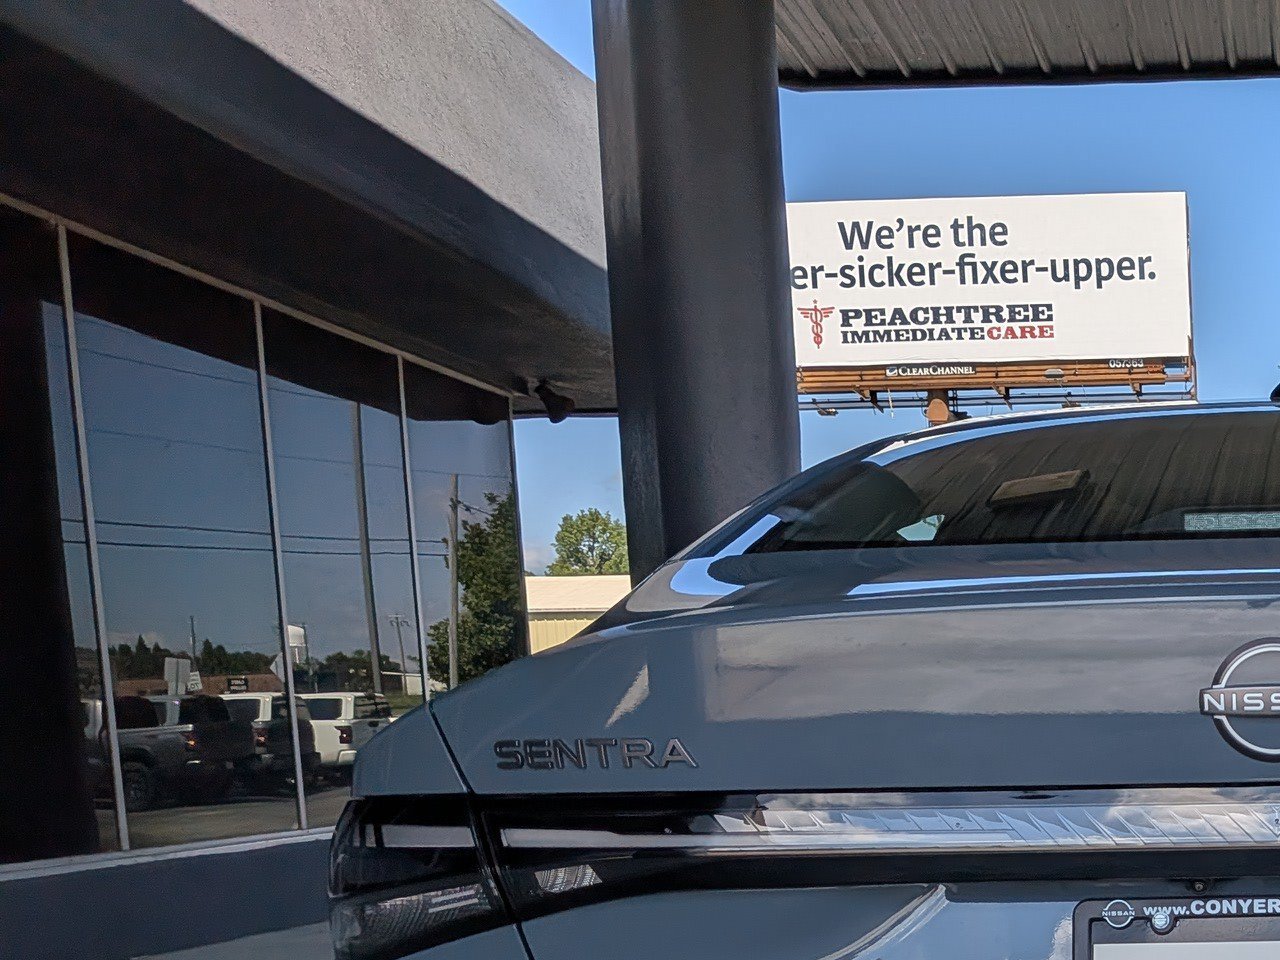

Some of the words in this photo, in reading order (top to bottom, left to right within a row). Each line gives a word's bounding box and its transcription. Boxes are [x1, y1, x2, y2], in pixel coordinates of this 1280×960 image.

[837, 218, 941, 250] We're
[950, 216, 1009, 248] the
[839, 304, 1053, 327] PEACHTREE
[494, 738, 699, 769] SENTRA
[1102, 909, 1136, 917] NISSAN
